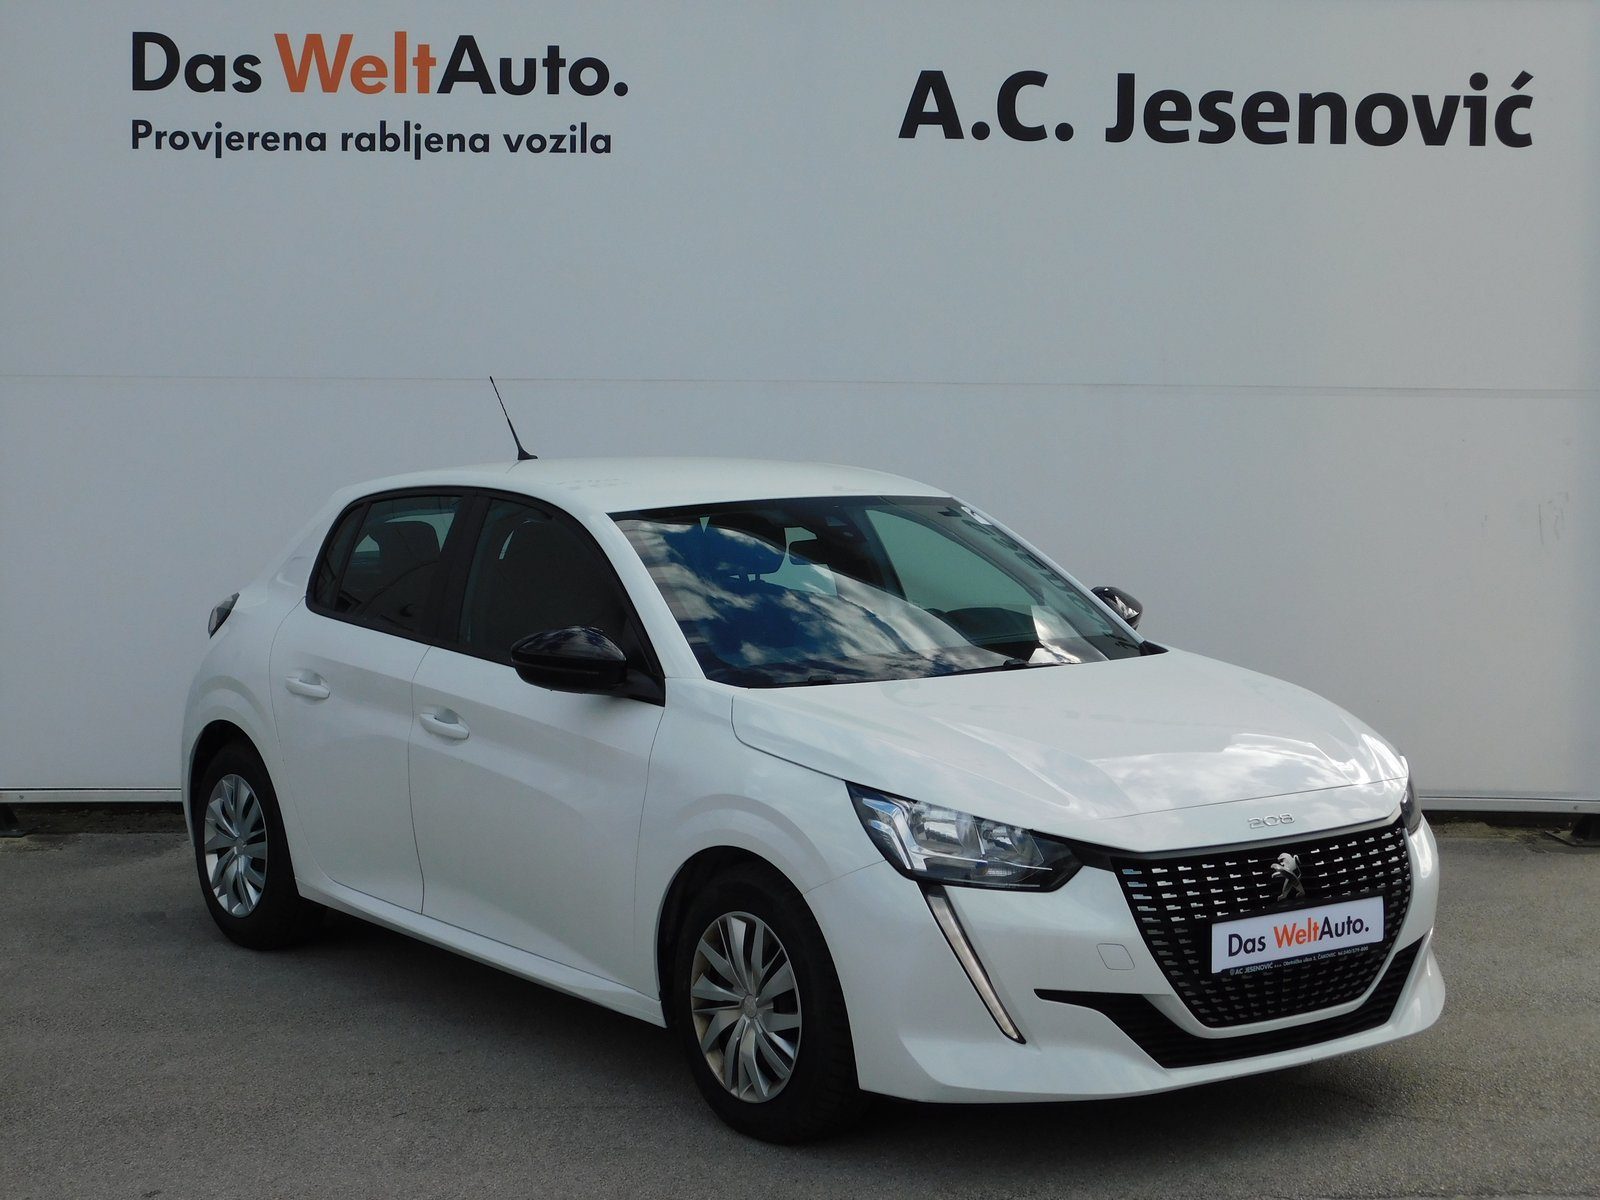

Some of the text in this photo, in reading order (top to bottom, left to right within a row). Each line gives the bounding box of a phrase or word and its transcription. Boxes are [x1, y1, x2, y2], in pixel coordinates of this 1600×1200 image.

[132, 31, 628, 96] Das WeltAuto.
[898, 70, 1533, 148] A.C. Jesenović
[132, 120, 611, 160] Provjerena rabljena vozila
[1248, 812, 1295, 829] 208
[1228, 916, 1370, 957] Das WeltAuto.
